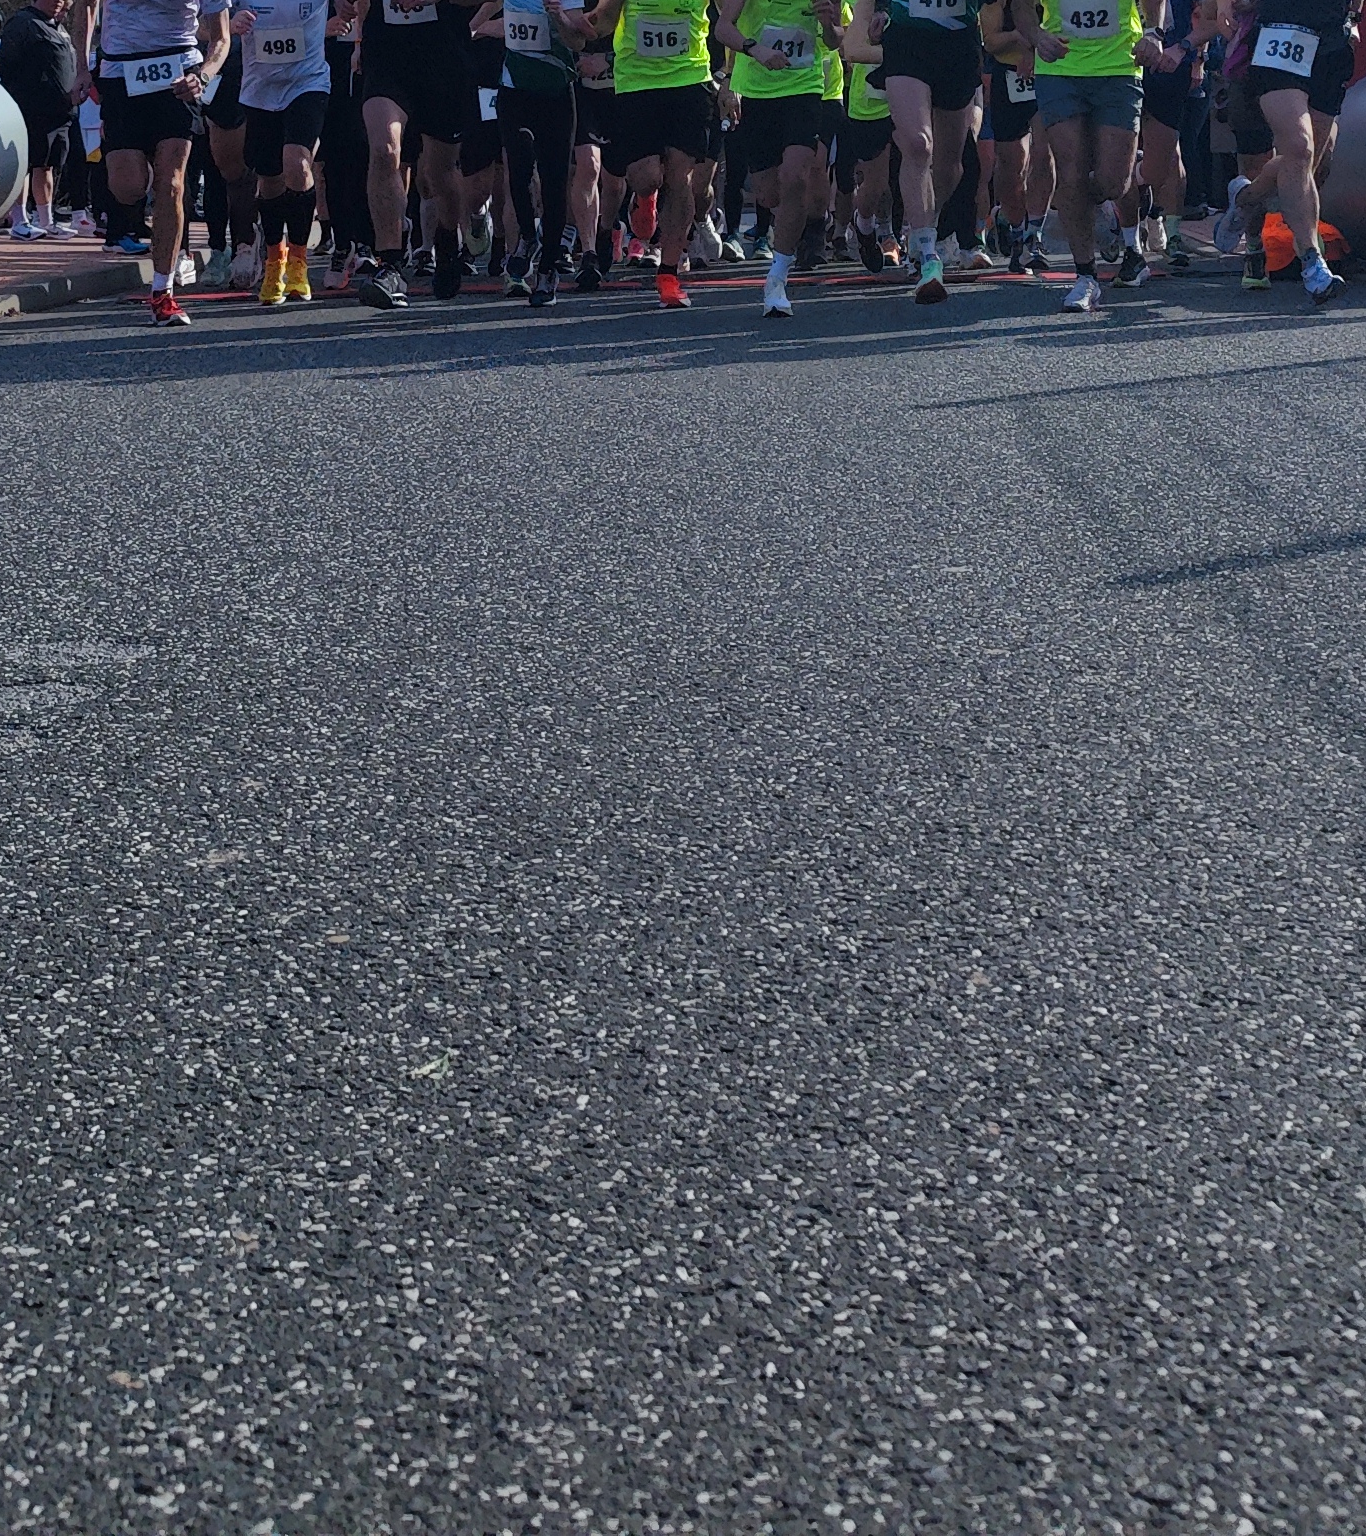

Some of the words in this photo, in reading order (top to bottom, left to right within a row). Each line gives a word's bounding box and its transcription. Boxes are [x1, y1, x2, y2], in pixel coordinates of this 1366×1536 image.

[1070, 9, 1110, 29] 432
[508, 23, 539, 41] 397
[643, 31, 678, 47] 516
[262, 38, 297, 55] 498
[1265, 39, 1305, 64] 338
[135, 62, 173, 83] 483
